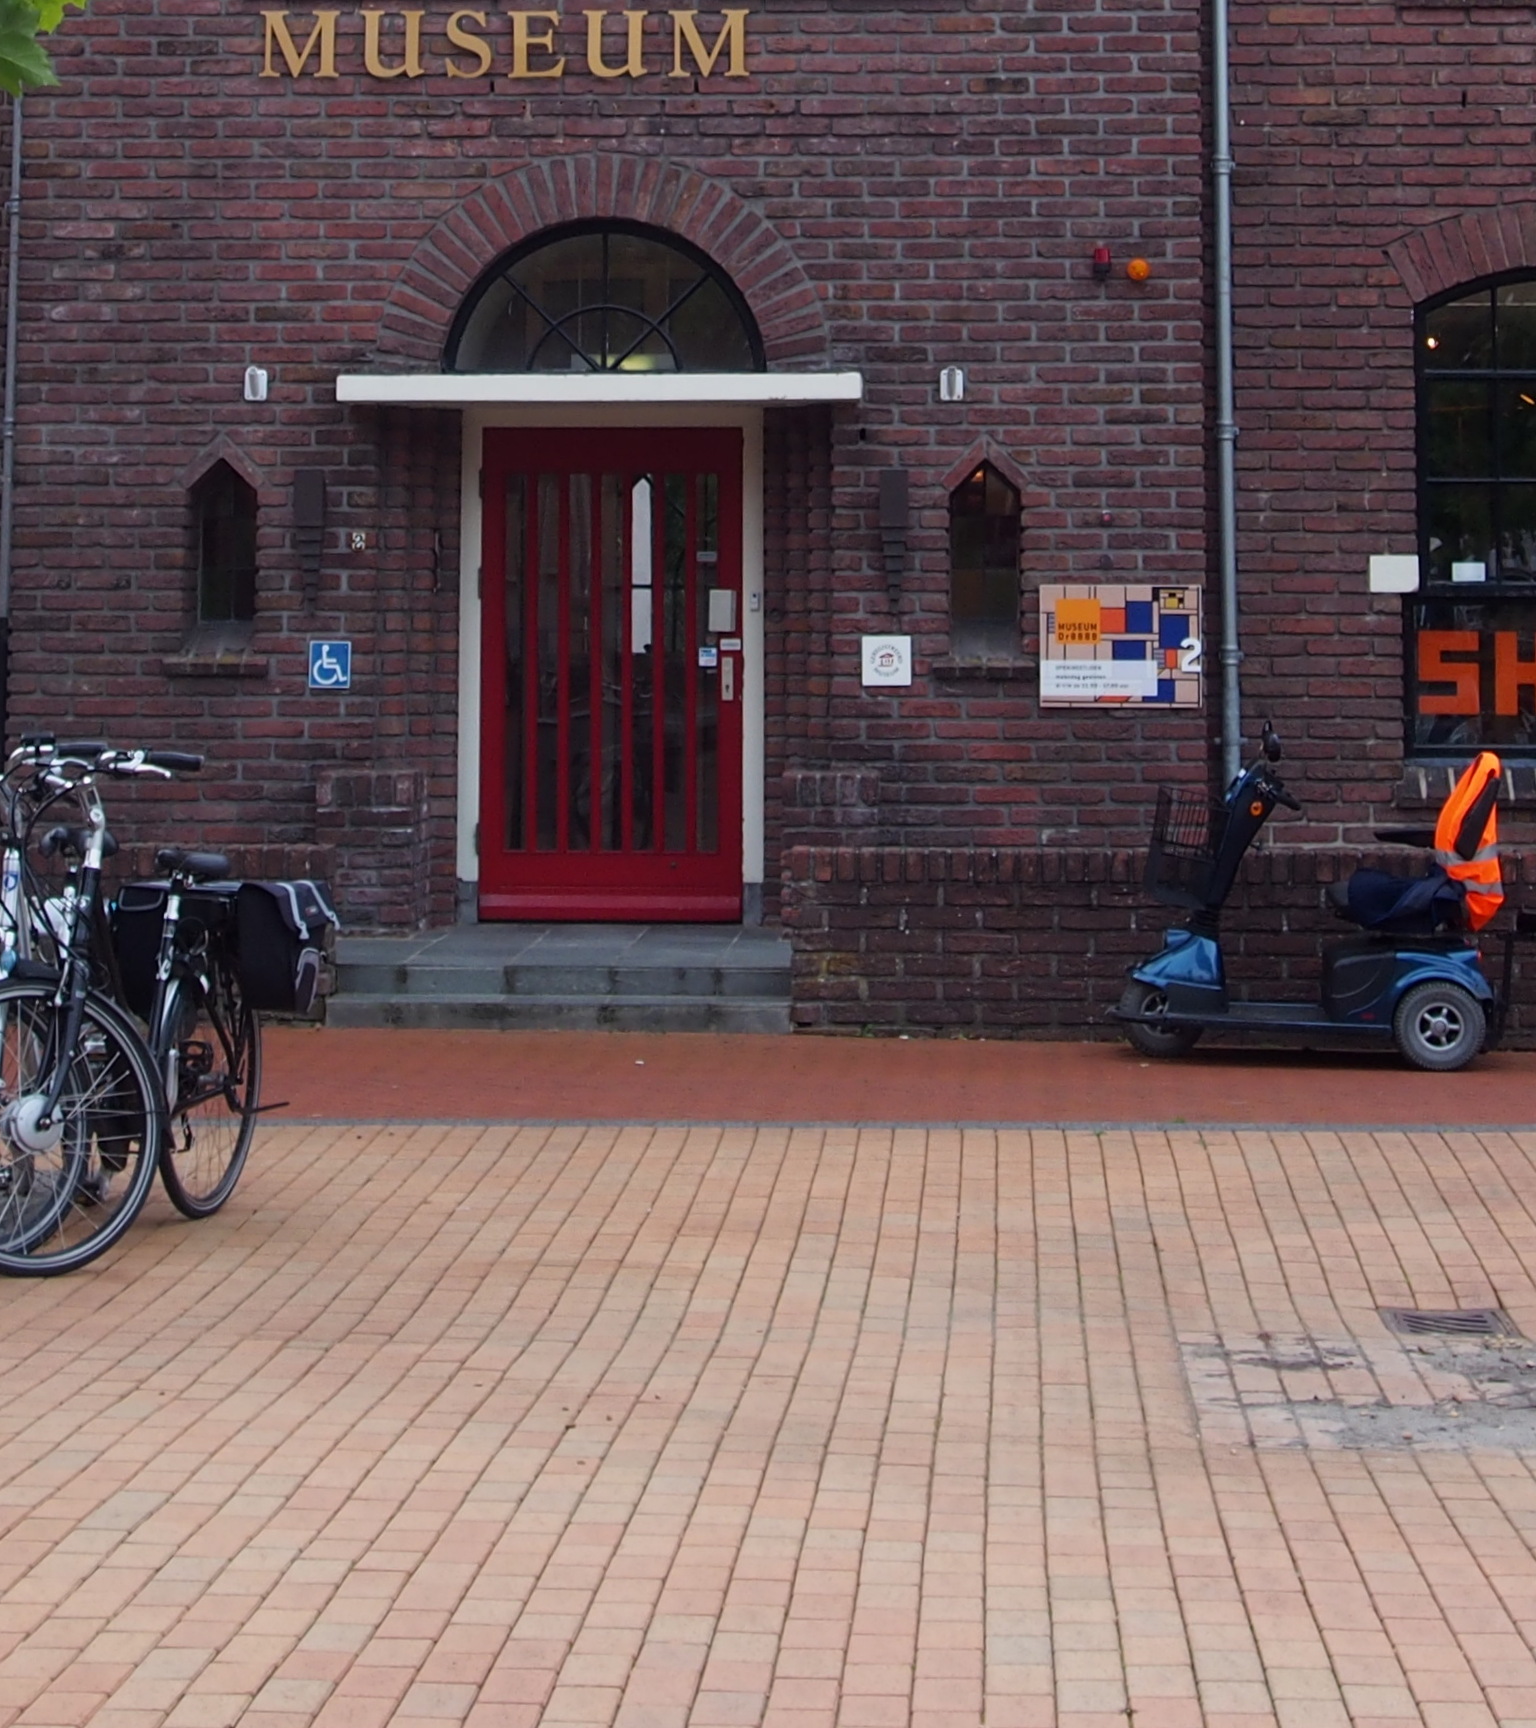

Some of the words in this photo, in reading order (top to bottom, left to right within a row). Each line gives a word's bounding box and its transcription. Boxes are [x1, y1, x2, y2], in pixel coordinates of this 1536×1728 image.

[258, 9, 751, 79] MUSEUM
[1057, 623, 1098, 632] MUSEUM
[1180, 636, 1202, 673] 2
